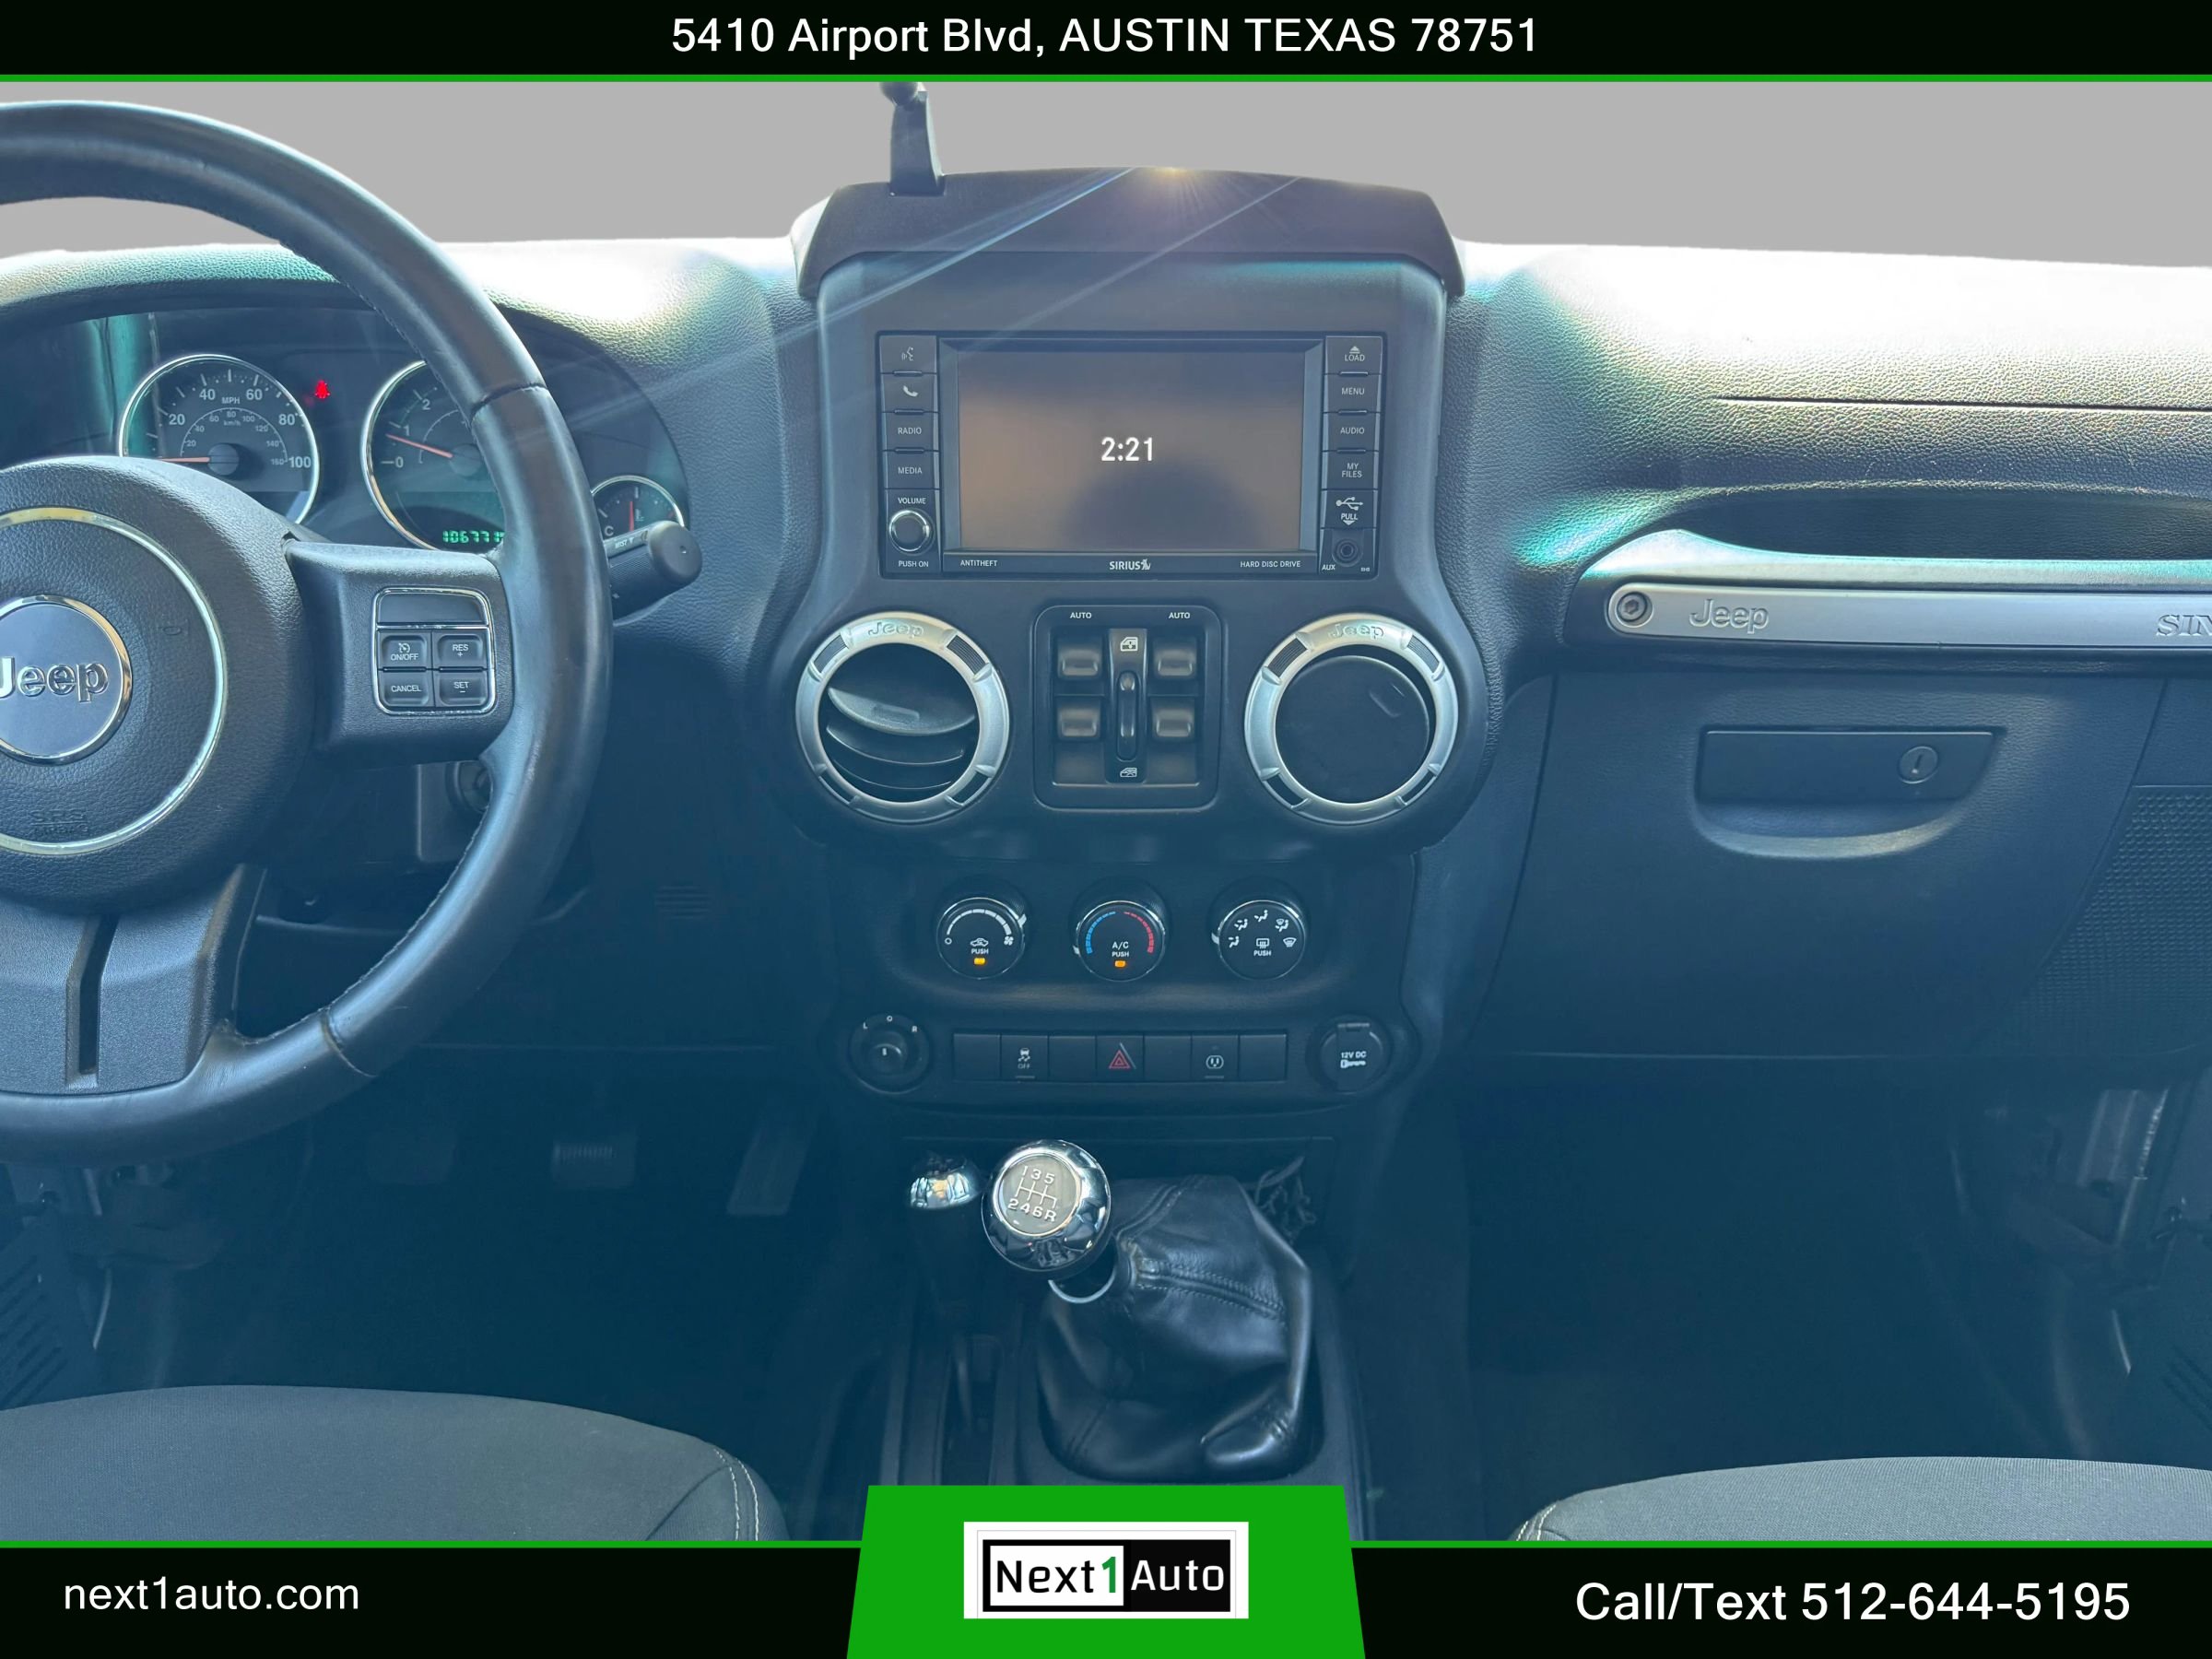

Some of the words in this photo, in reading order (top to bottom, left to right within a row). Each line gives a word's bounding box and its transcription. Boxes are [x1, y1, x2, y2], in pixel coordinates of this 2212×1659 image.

[1344, 354, 1365, 362] LOAD
[199, 388, 216, 400] 40
[245, 388, 263, 400] 60
[1341, 386, 1365, 395] MENU
[221, 396, 241, 405] MPH
[421, 398, 430, 410] 2
[169, 414, 185, 426] 20
[278, 414, 295, 426] 80
[898, 427, 923, 435] RADIO
[1340, 427, 1365, 435] AUDIO
[1100, 436, 1153, 462] 2:21
[289, 456, 312, 468] 100
[395, 456, 404, 468] 0
[898, 466, 923, 476] MEDIA
[1347, 463, 1359, 471] MY
[1342, 470, 1362, 478] FILES
[898, 497, 926, 505] VOLUME
[1340, 512, 1359, 521] PULL
[605, 525, 614, 536] C
[898, 559, 918, 568] PUSH
[919, 559, 929, 568] ON
[960, 559, 997, 567] ANTITHEFT
[1109, 560, 1141, 571] SIRIUS
[1240, 559, 1259, 568] HARD
[1261, 559, 1278, 568] DISC
[1280, 559, 1301, 568] DRIVE
[1069, 611, 1092, 619] AUTO
[1168, 611, 1191, 619] AUTO
[1689, 598, 1770, 633] Jeep
[867, 619, 924, 638] Jeep
[1328, 624, 1383, 640] Jeep
[453, 643, 468, 652] RES
[391, 653, 418, 661] ON/OFF
[0, 655, 110, 703] Jeep
[391, 684, 421, 693] CANCEL
[453, 680, 469, 689] SET
[1112, 940, 1129, 950] A/C
